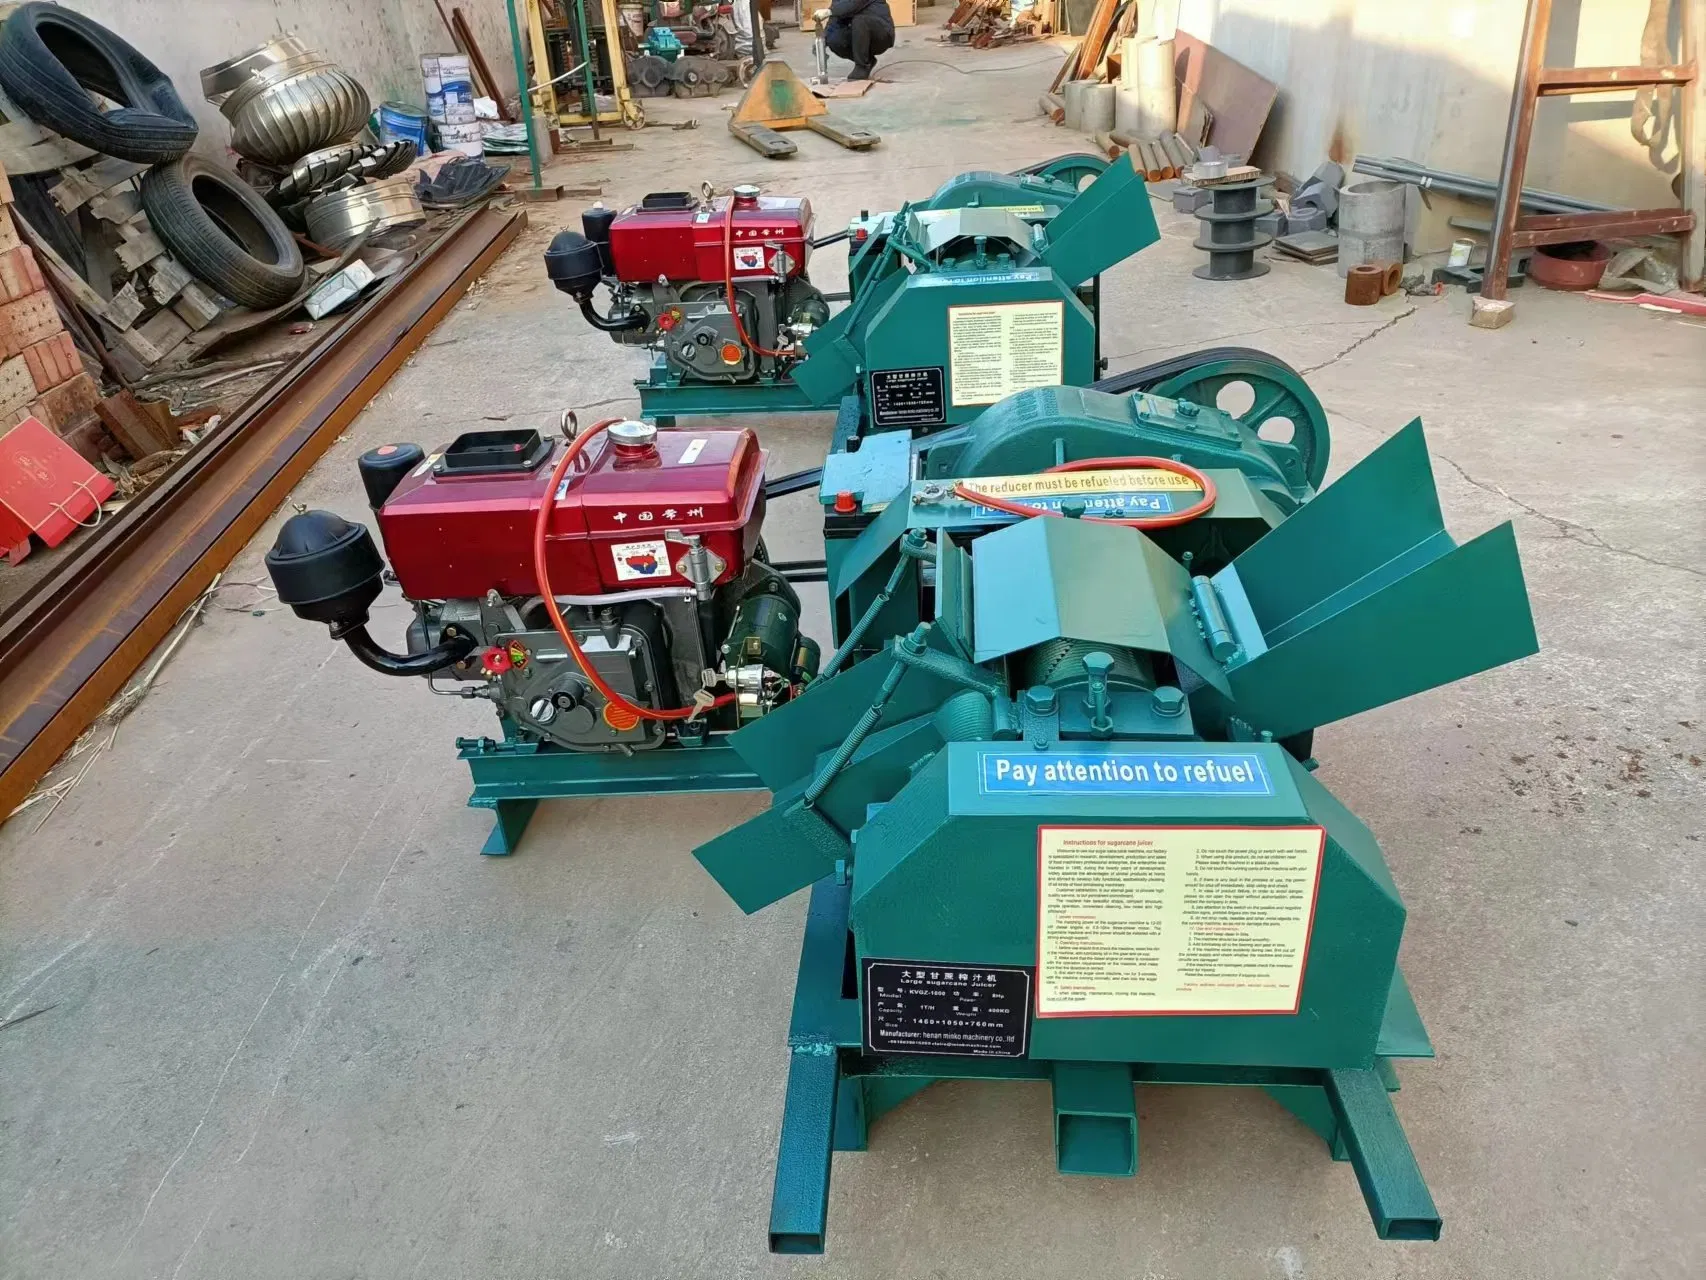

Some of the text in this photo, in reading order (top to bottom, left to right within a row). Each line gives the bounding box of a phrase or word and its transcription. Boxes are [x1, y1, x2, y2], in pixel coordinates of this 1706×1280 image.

[990, 482, 1032, 494] reducer
[1034, 480, 1062, 492] must
[1064, 477, 1078, 489] be
[1080, 475, 1127, 488] refueled
[1129, 473, 1166, 486] before
[1167, 474, 1189, 485] use
[1052, 498, 1126, 510] attenn
[1131, 498, 1160, 510] Pay
[996, 759, 1255, 786] Pay attention to refuel
[880, 1029, 922, 1038] Manufacturer:
[963, 1034, 994, 1043] machinery
